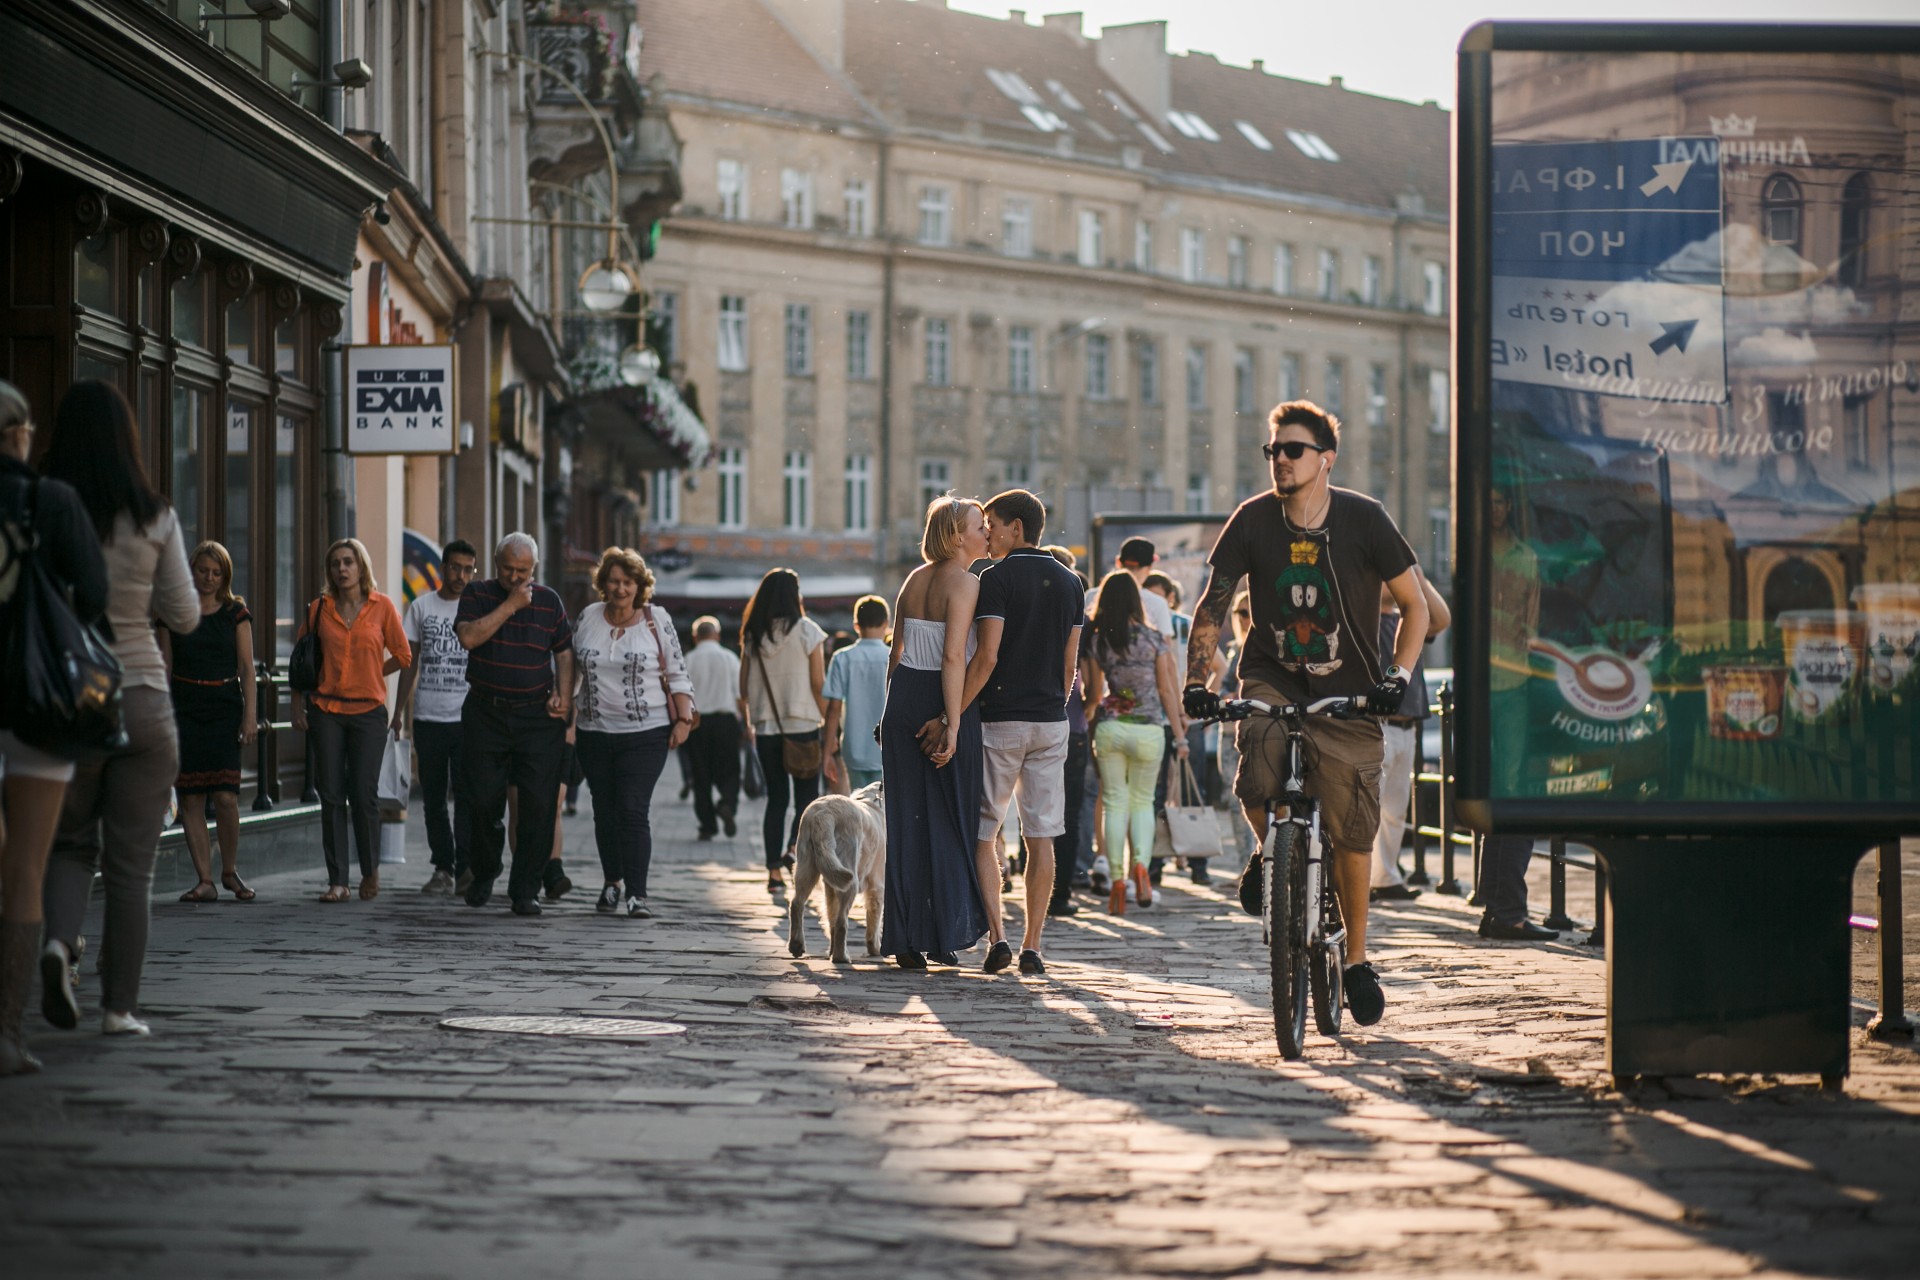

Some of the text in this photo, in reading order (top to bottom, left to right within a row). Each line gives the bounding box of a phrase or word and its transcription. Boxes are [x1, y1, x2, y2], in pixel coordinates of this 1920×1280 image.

[373, 371, 429, 382] UKR
[357, 387, 444, 413] EXIM
[357, 416, 443, 429] BANK
[1551, 711, 1652, 743] НОВИНКА
